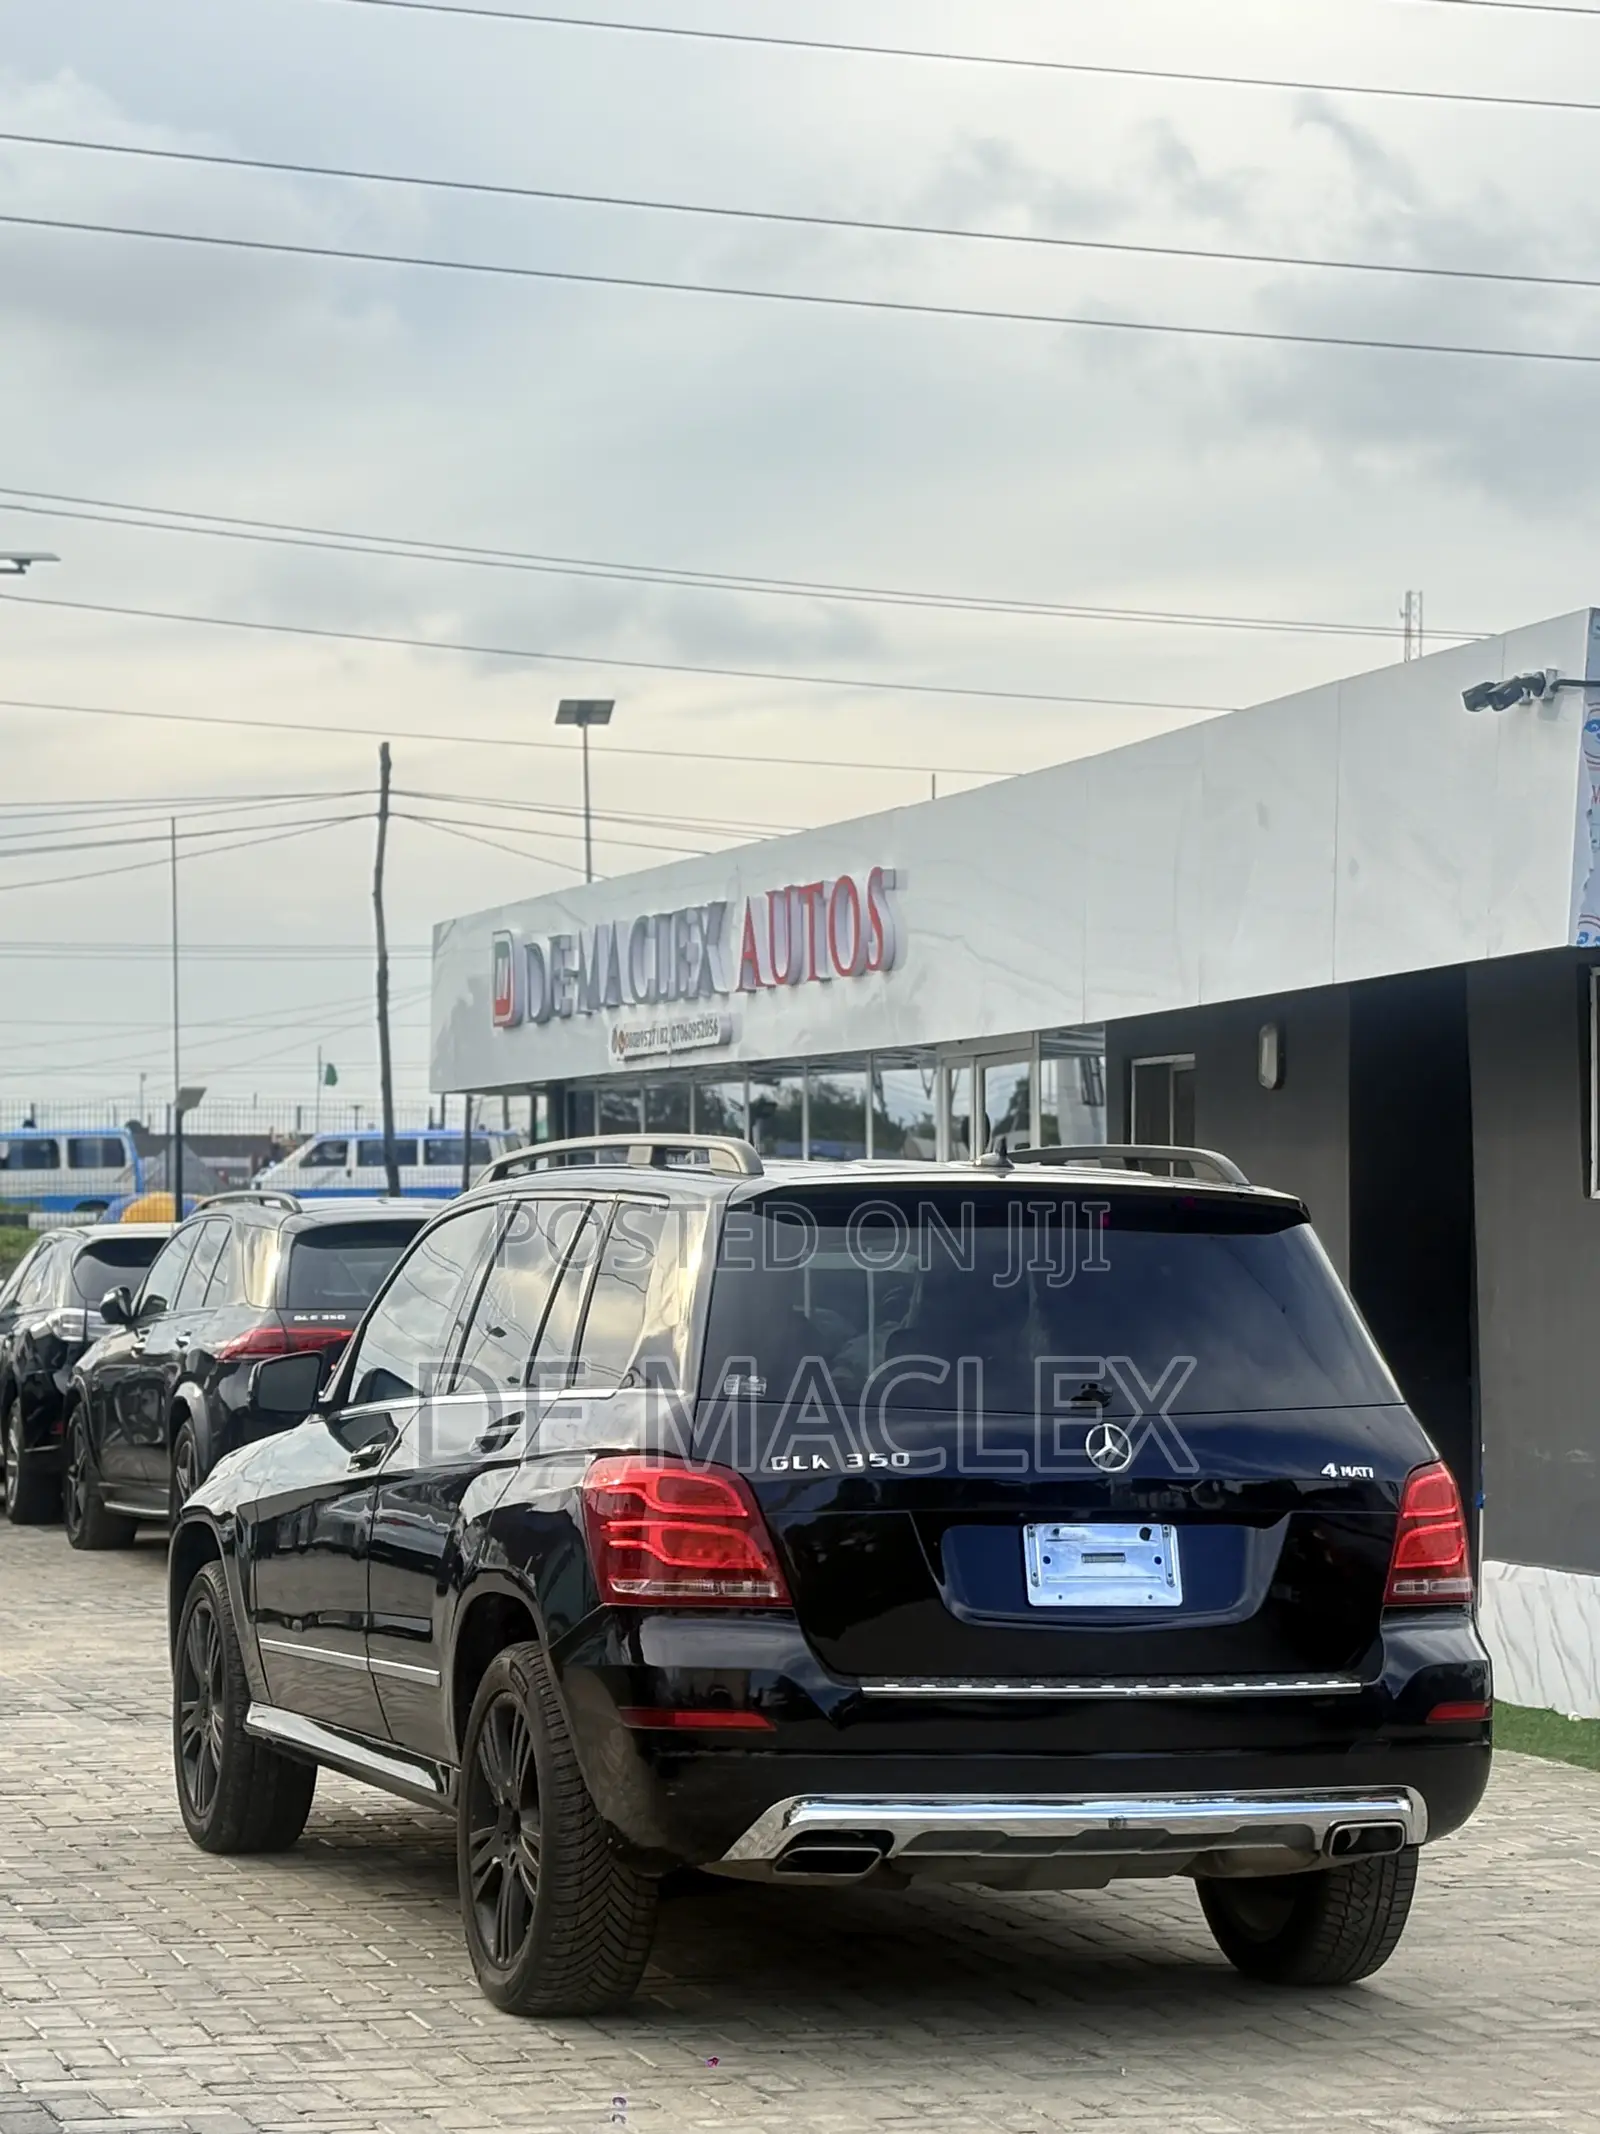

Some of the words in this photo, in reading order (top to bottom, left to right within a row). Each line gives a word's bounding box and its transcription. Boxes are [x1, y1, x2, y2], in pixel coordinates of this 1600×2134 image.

[735, 866, 898, 993] AUTOS
[770, 1454, 831, 1472] GLK
[846, 1452, 911, 1468] 350
